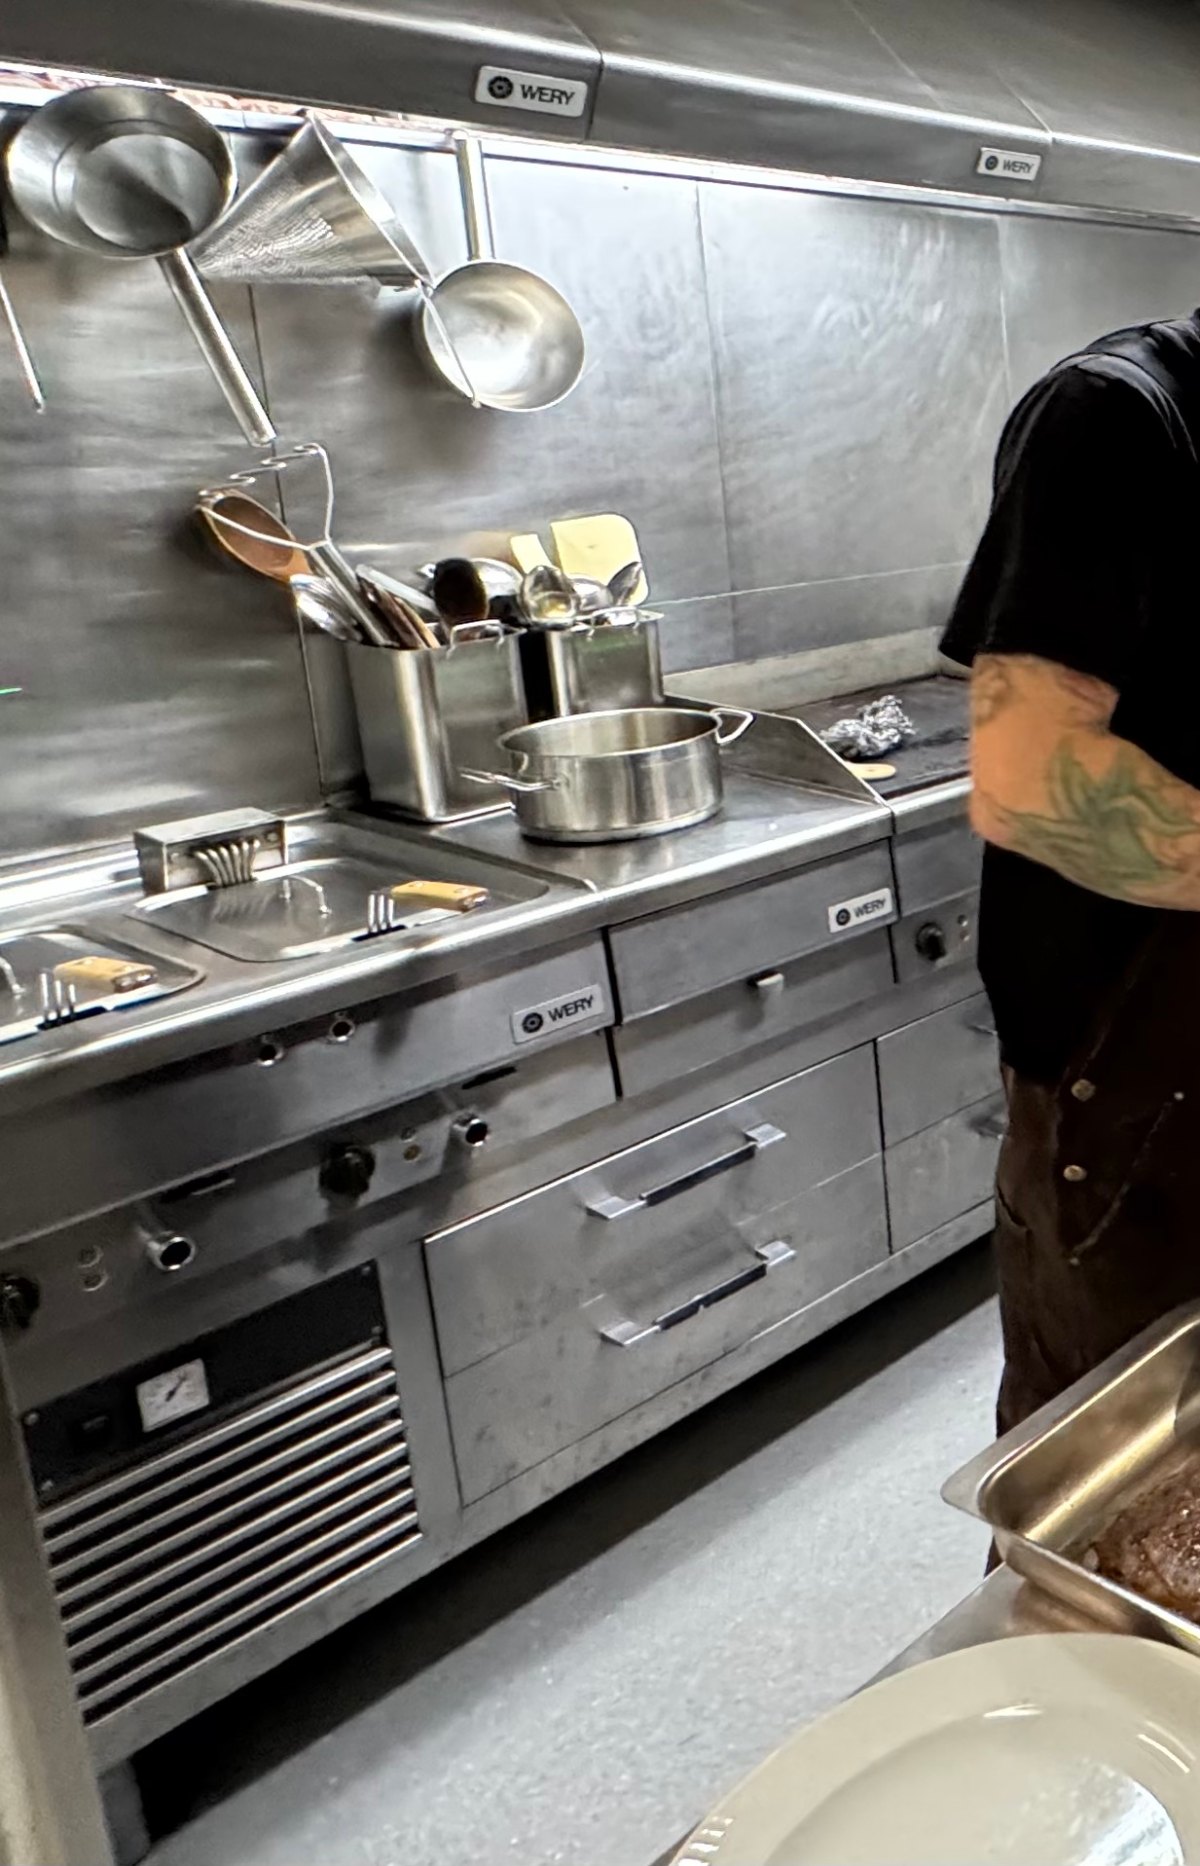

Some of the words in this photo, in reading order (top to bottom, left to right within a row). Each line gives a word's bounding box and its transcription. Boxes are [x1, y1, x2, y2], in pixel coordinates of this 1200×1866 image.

[520, 84, 576, 105] WERY
[1002, 159, 1035, 174] WERY
[853, 897, 886, 918] WERY
[547, 994, 594, 1022] WERY
